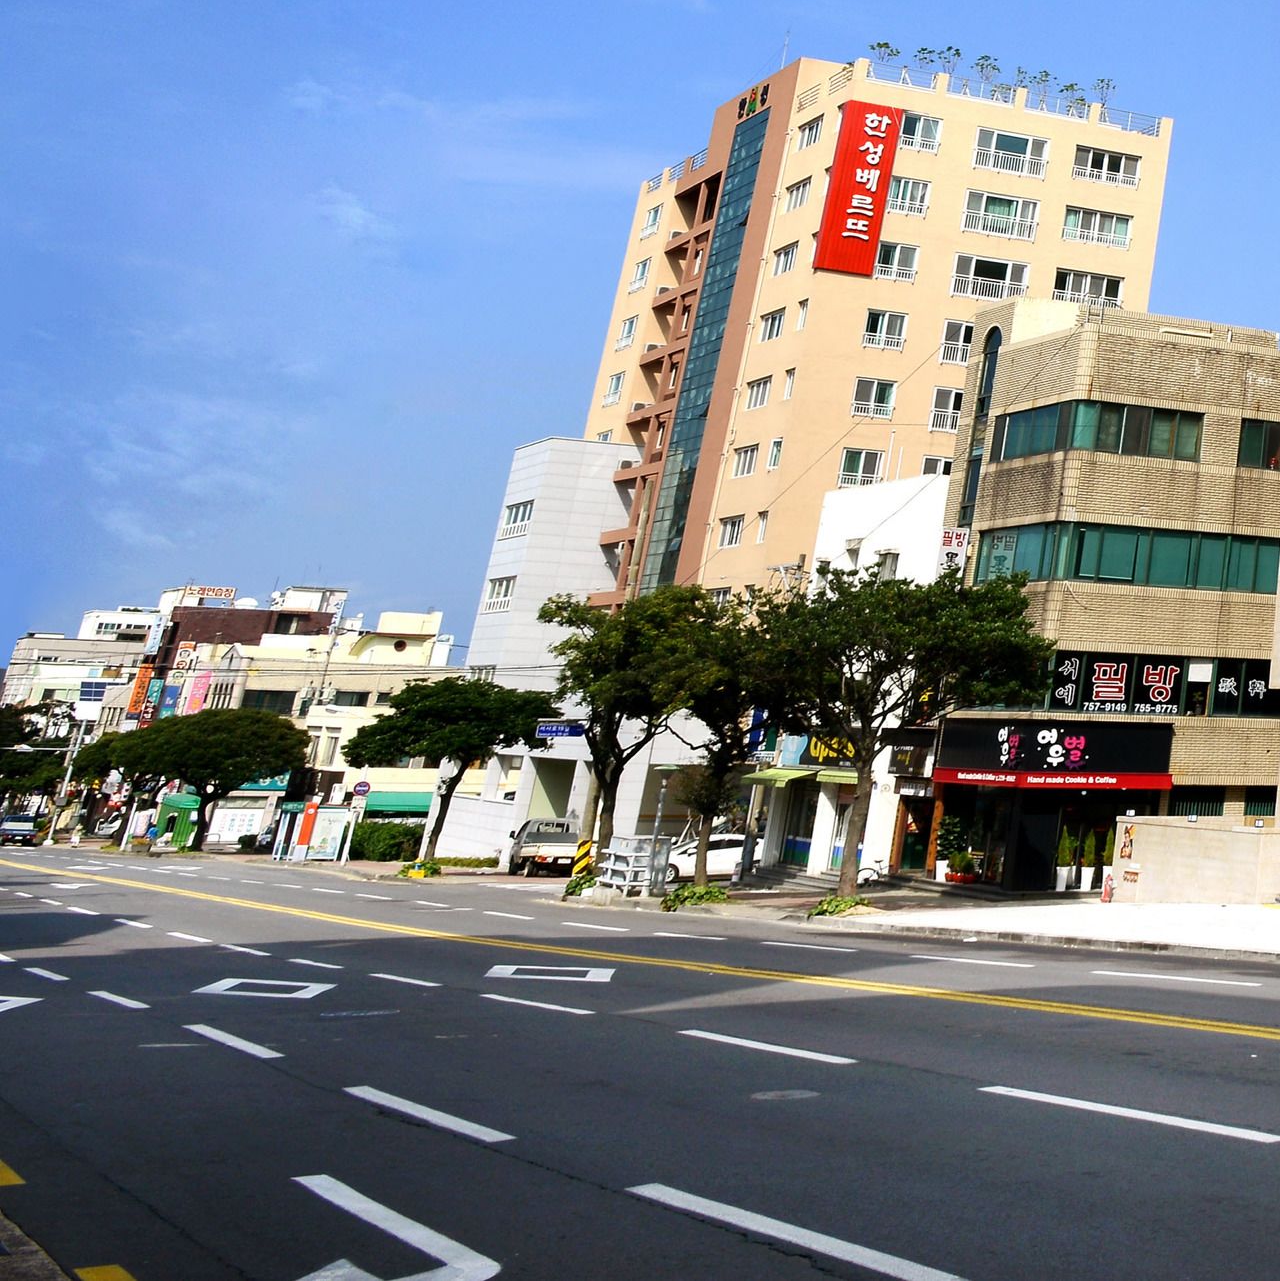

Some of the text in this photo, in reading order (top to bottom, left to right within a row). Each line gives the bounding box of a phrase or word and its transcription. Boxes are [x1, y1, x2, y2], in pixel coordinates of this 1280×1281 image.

[841, 112, 892, 241] 한성베르뜨
[943, 531, 966, 547] 필방
[187, 587, 234, 598] 노래연습장
[1056, 657, 1080, 706] 서예
[1092, 662, 1180, 703] 필방
[1082, 701, 1179, 714] 757-9149 755-8775
[1045, 776, 1064, 784] made
[1065, 776, 1087, 784] Cookie
[1095, 776, 1117, 784] Coffee
